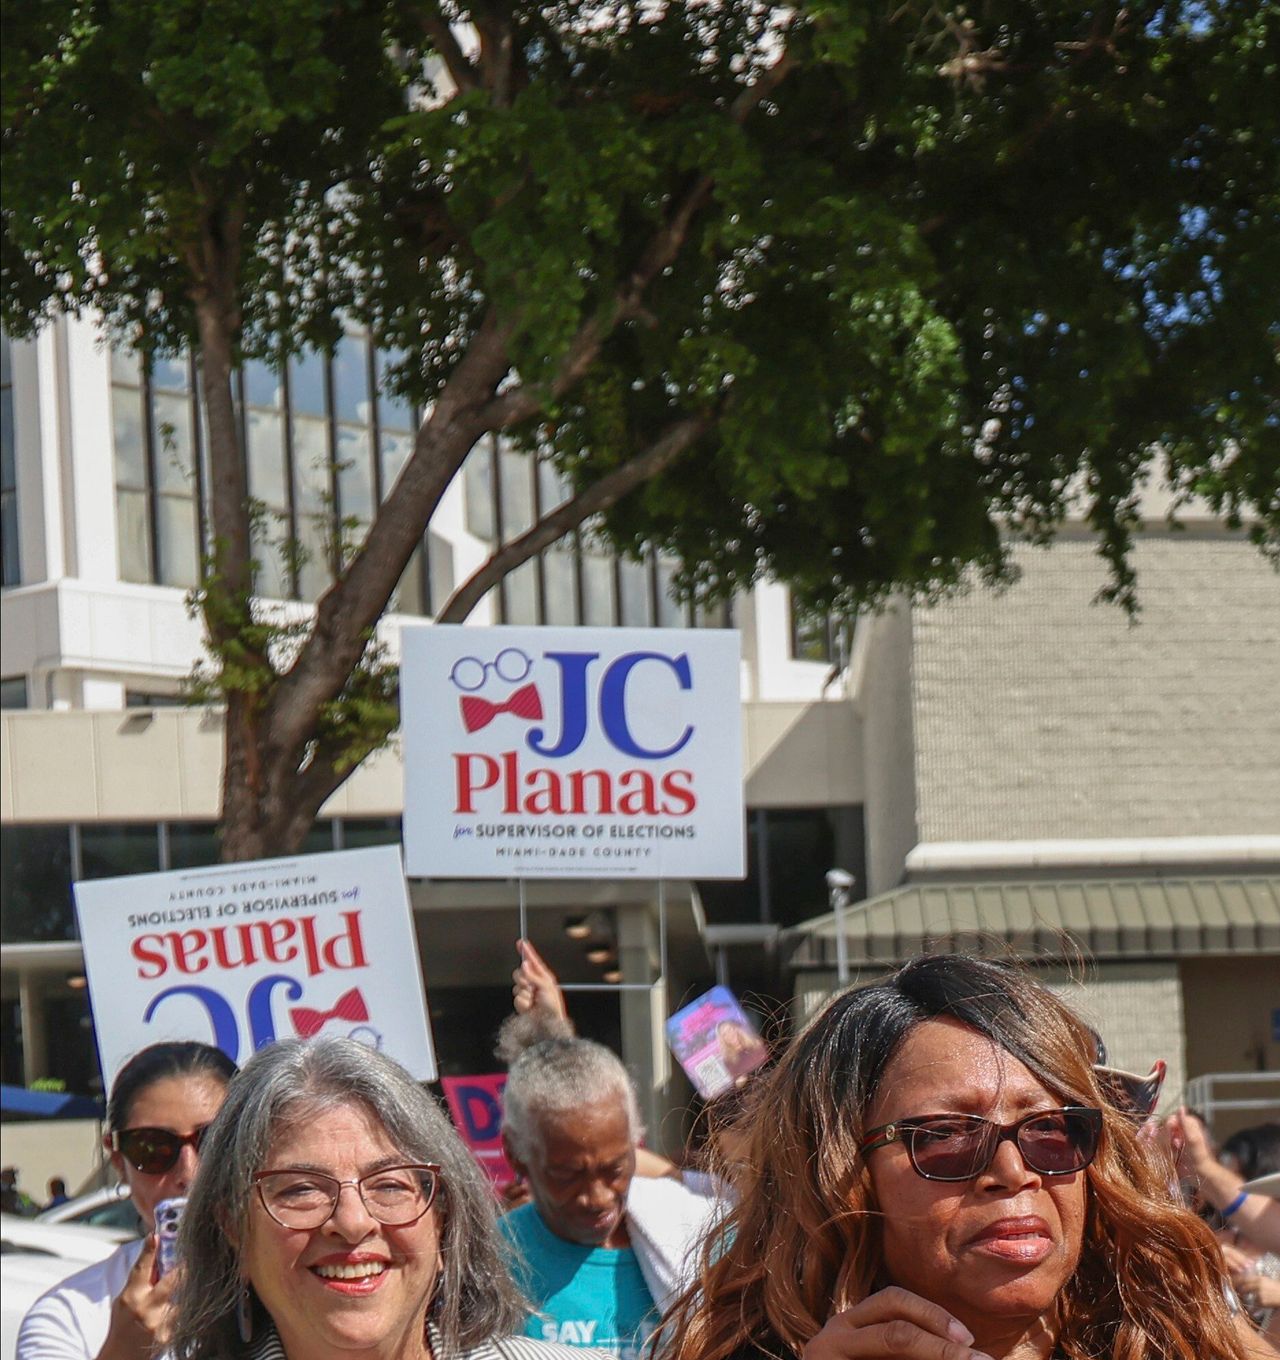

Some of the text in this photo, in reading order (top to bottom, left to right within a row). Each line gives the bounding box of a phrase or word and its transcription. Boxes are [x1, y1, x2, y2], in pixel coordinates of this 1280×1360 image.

[524, 651, 695, 760] JC
[451, 750, 697, 817] Planas
[453, 823, 696, 839] for SUPERVISOR OF ELECTIONS
[495, 847, 652, 858] MIAMI-DADE COUNTY
[168, 875, 317, 902] MIAMI-DADE COUNTY
[216, 903, 239, 918] OF
[241, 890, 338, 913] SUPERVISOR
[127, 905, 212, 928] ELECTIONS
[130, 909, 370, 980] Planas
[142, 974, 303, 1061] JC
[541, 1320, 598, 1344] SAY
